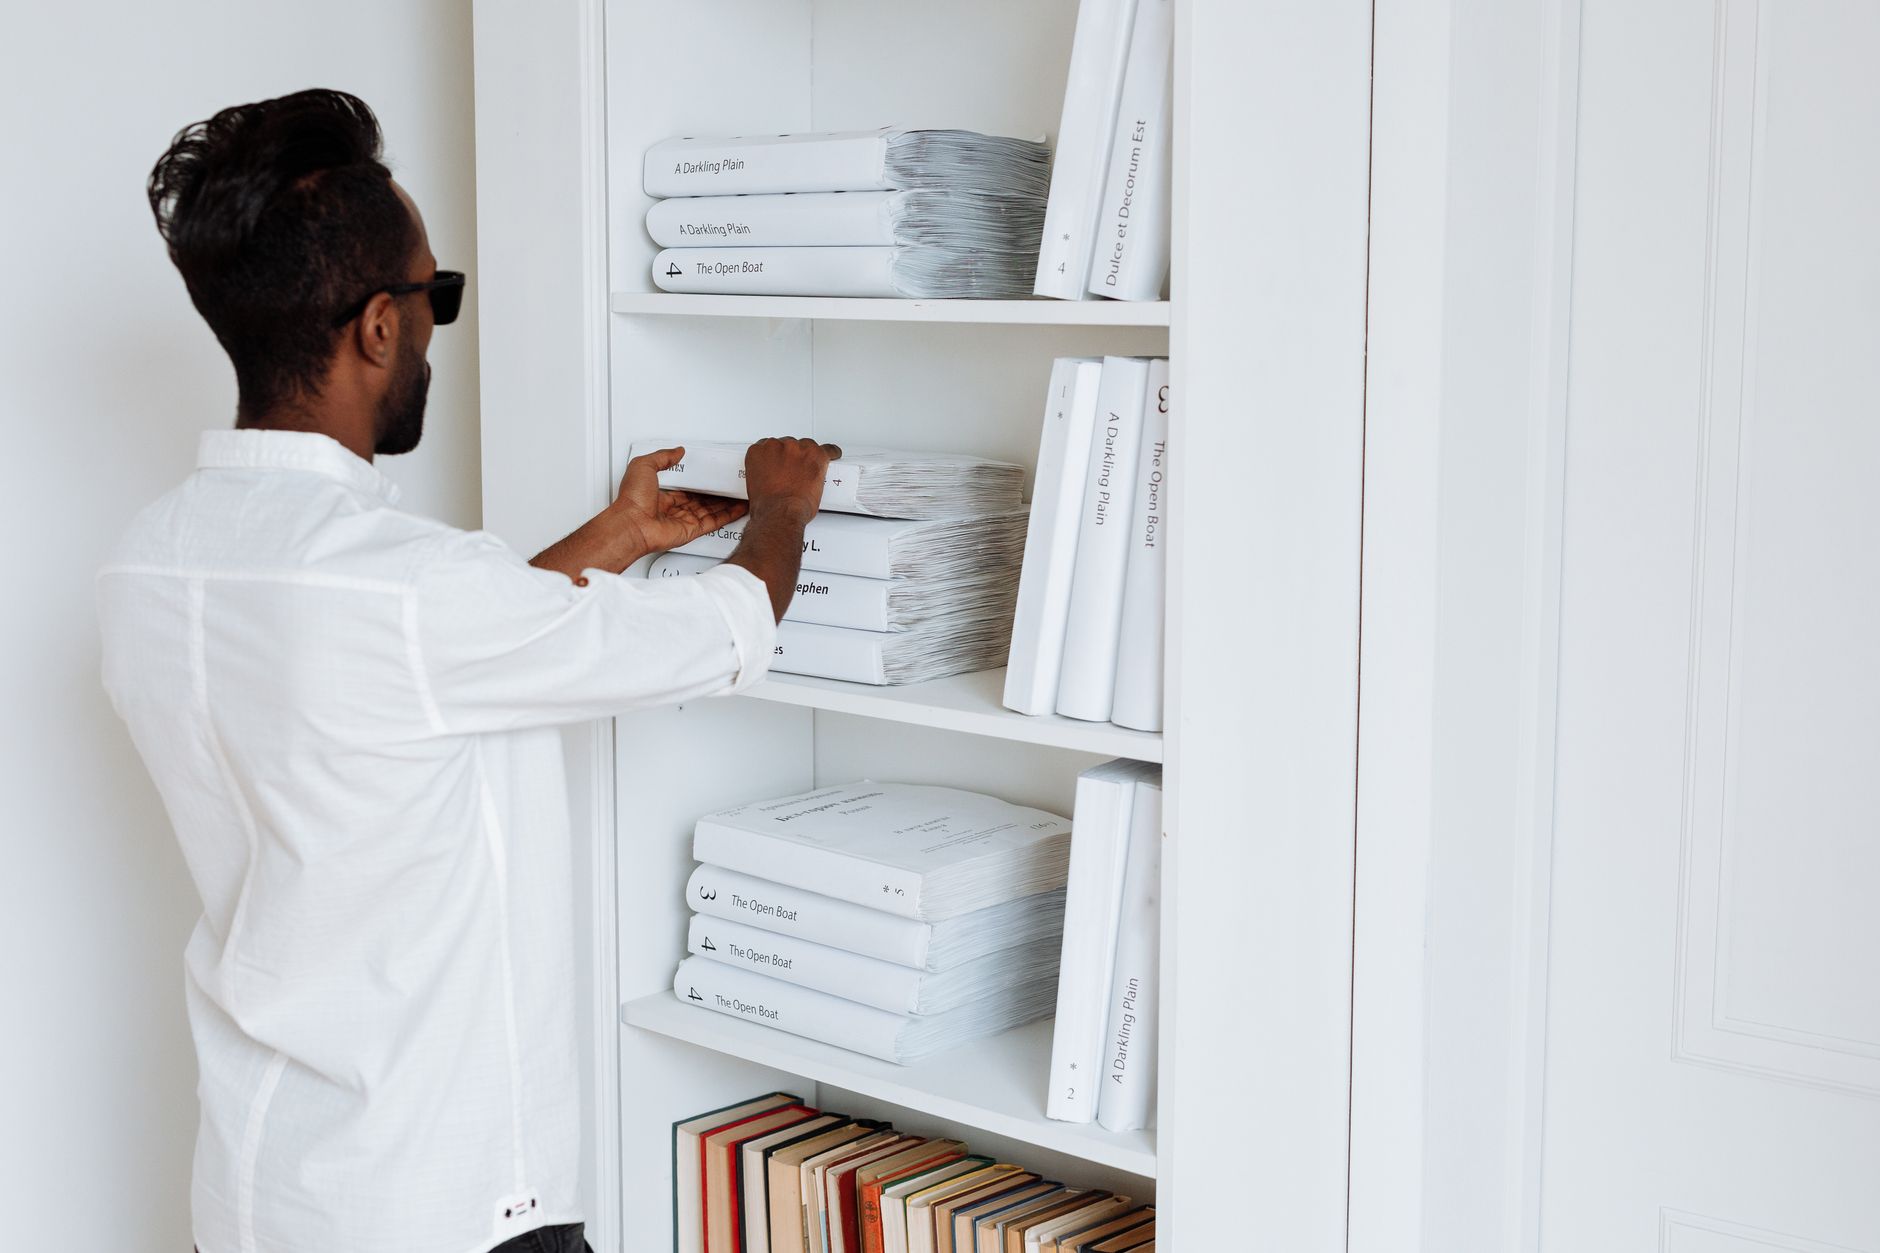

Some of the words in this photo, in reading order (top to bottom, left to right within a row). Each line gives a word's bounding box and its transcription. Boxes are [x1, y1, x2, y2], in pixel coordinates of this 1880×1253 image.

[1132, 119, 1146, 142] Est
[674, 163, 681, 174] A
[683, 161, 720, 174] Darkling
[722, 159, 744, 171] Plain
[1119, 148, 1141, 218] Decorum
[679, 224, 686, 235] A
[687, 224, 727, 237] Darkling
[726, 223, 751, 234] Plain
[1117, 224, 1128, 238] et
[666, 262, 682, 278] 4
[697, 262, 713, 274] The
[714, 262, 740, 276] Open
[742, 261, 763, 273] Boat
[1058, 262, 1065, 274] 4
[1106, 242, 1124, 286] Dulce
[1158, 385, 1169, 414] 3
[1109, 412, 1120, 422] A
[1098, 427, 1119, 488] Darkling
[1152, 441, 1165, 467] The
[832, 479, 842, 487] 4
[1148, 472, 1162, 511] Open
[1095, 491, 1110, 526] Plain
[1145, 515, 1158, 548] Boat
[811, 539, 820, 552] L.
[699, 886, 716, 901] 3
[732, 894, 748, 909] The
[750, 899, 774, 915] Open
[776, 905, 798, 922] Boat
[701, 936, 717, 951] 4
[730, 944, 745, 958] The
[747, 949, 770, 964] Open
[772, 954, 793, 970] Boat
[688, 987, 703, 1001] 4
[1123, 977, 1139, 1010] Plain
[715, 994, 732, 1009] The
[733, 999, 757, 1014] Open
[759, 1005, 779, 1021] Boat
[1114, 1010, 1136, 1071] Darkling
[1112, 1073, 1123, 1084] A
[1067, 1087, 1076, 1100] 2
